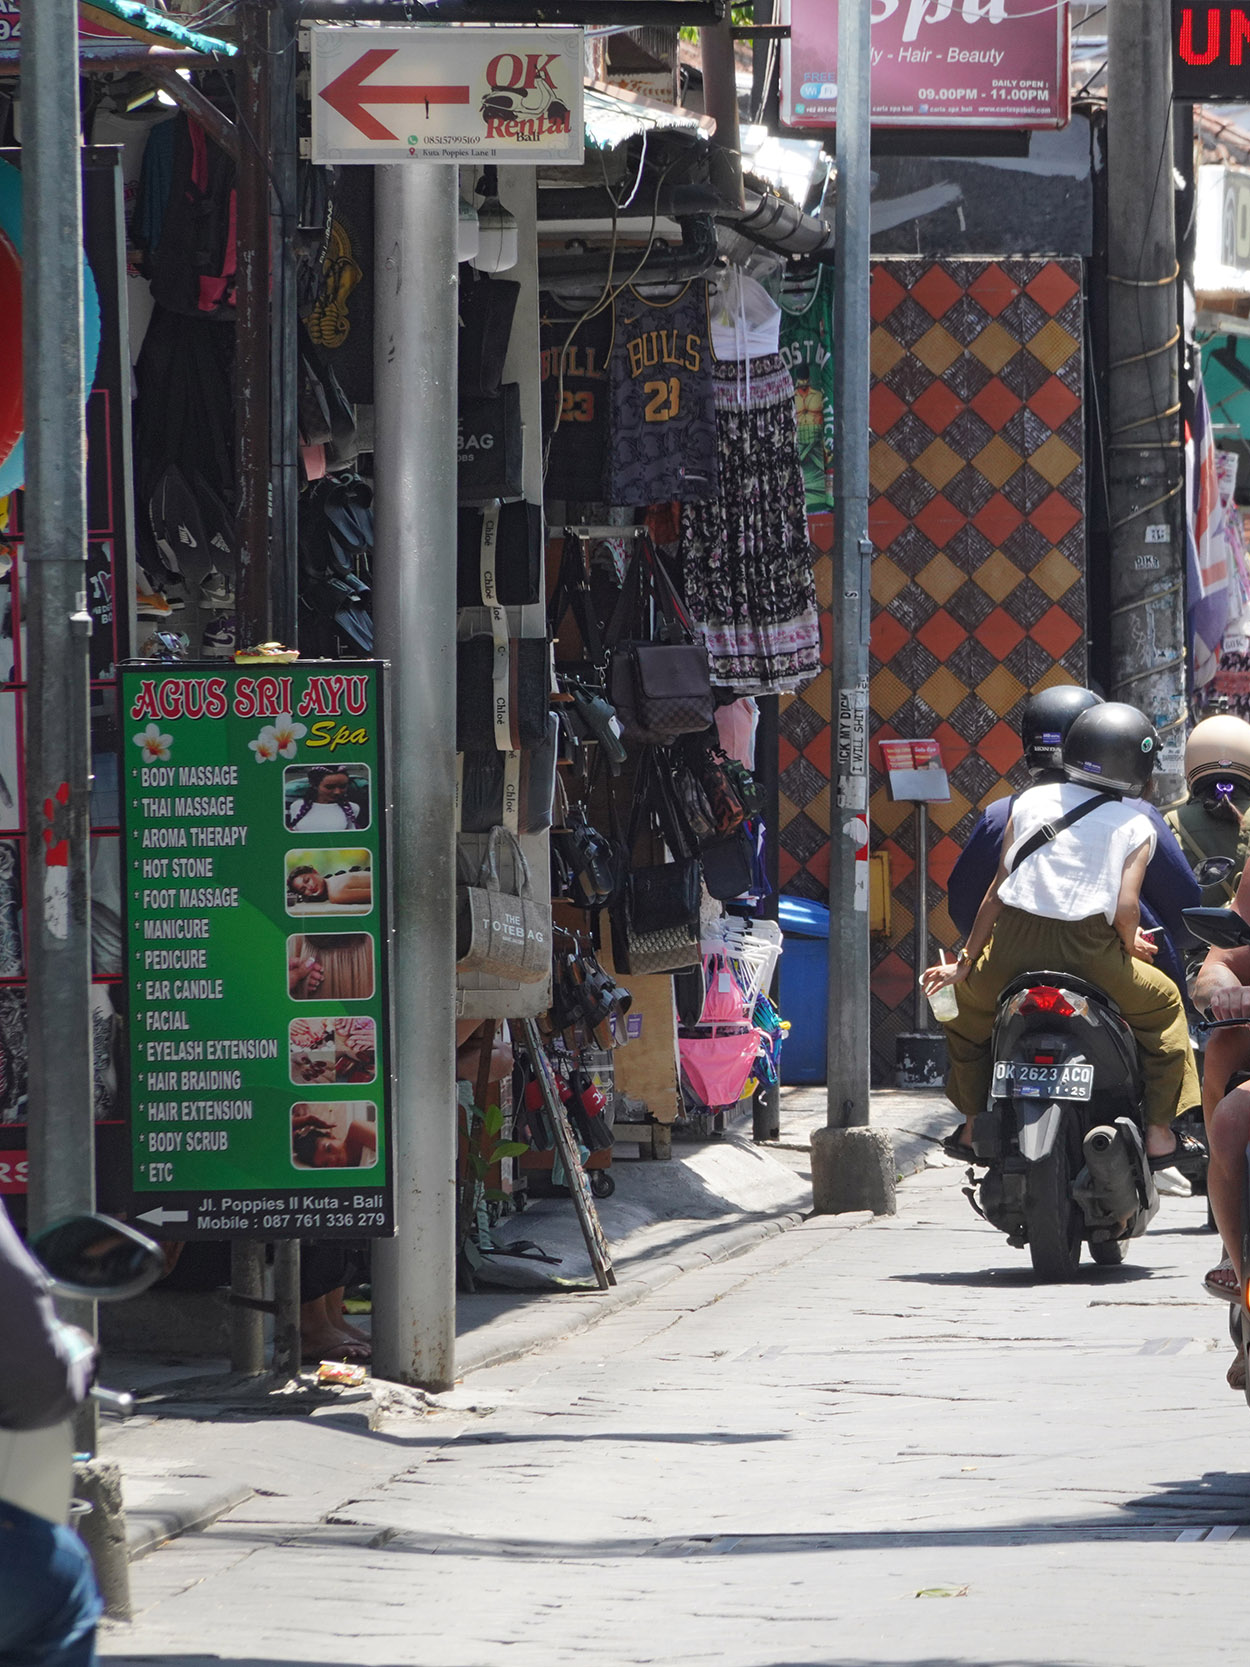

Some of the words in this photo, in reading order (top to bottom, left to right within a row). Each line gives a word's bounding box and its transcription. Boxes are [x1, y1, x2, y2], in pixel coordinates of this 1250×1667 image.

[899, 47, 932, 63] Hair
[947, 48, 1005, 66] Beauty
[804, 72, 835, 82] FREE
[992, 80, 1017, 88] DAILY
[918, 89, 978, 100] 09.00PM
[990, 89, 1050, 101] 11.00PM
[484, 110, 572, 139] Rental
[516, 131, 541, 143] Bali
[423, 149, 440, 157] Kuta
[442, 149, 469, 159] Poppies
[471, 149, 489, 157] Lane
[626, 329, 701, 379] BULLS
[555, 390, 594, 422] 23
[484, 520, 495, 547] Chloé
[483, 571, 494, 599] Chloé
[130, 678, 228, 720] AGUS
[233, 676, 293, 719] SRI
[297, 675, 370, 717] AYU
[496, 697, 506, 726] Chloé
[305, 720, 369, 752] Spa
[839, 723, 851, 739] MY
[852, 738, 864, 763] WILL
[141, 767, 176, 787] BODY
[179, 766, 238, 786] MASSAGE
[141, 798, 172, 818] THAI
[175, 796, 234, 817] MASSAGE
[506, 784, 517, 814] Chloé
[142, 828, 187, 848] AROMA
[190, 826, 248, 847] THERAPY
[143, 859, 169, 878] HOT
[172, 858, 213, 878] STONE
[143, 889, 176, 909] FOOT
[180, 888, 239, 908] MASSAGE
[144, 919, 210, 939] MANICURE
[505, 913, 521, 926] THE
[145, 950, 207, 970] PEDICURE
[145, 981, 170, 1000] EAR
[173, 979, 224, 999] CANDLE
[146, 1011, 190, 1031] FACIAL
[147, 1041, 203, 1061] EYELASH
[206, 1039, 278, 1060] EXTENSION
[147, 1072, 178, 1091] HAIR
[181, 1070, 241, 1091] BRAIDING
[1019, 1067, 1058, 1081] 2623
[148, 1102, 178, 1121] HAIR
[181, 1101, 253, 1121] EXTENSION
[149, 1132, 183, 1152] BODY
[186, 1131, 228, 1151] SCRUB
[149, 1162, 173, 1182] ETC
[198, 1199, 217, 1212] Jl.
[221, 1198, 285, 1214] Poppies
[289, 1197, 299, 1209] II
[303, 1196, 339, 1210] Kuta
[353, 1194, 383, 1209] Bali
[197, 1215, 249, 1230] Mobile
[263, 1214, 290, 1228] 087
[294, 1214, 321, 1227] 761
[326, 1213, 353, 1227] 336
[358, 1212, 385, 1226] 279
